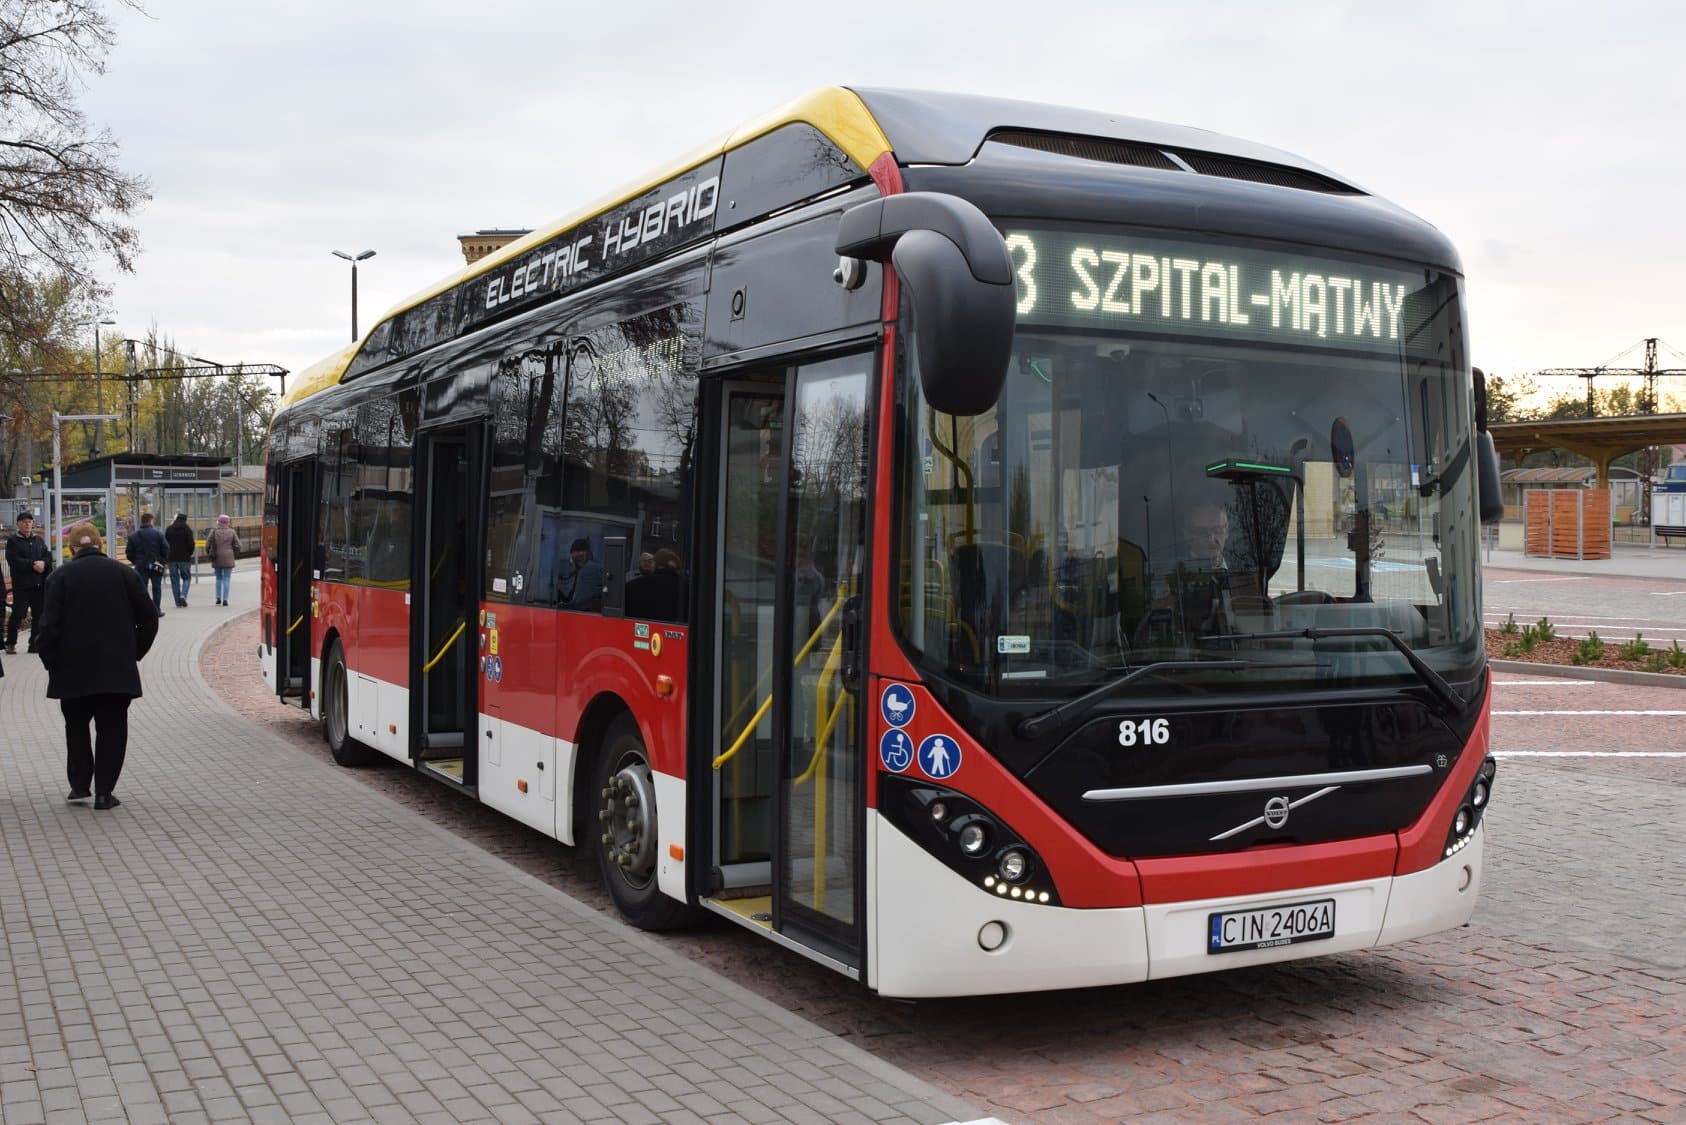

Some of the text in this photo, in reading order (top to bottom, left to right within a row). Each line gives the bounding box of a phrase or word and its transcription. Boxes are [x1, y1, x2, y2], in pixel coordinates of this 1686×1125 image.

[486, 176, 720, 310] ELECTRIC HYBRID
[1071, 247, 1405, 339] SZPITAL-MĄTWY
[1118, 718, 1170, 747] 816
[1211, 905, 1331, 944] PL CIN 2406A
[1257, 941, 1274, 949] VOLVO
